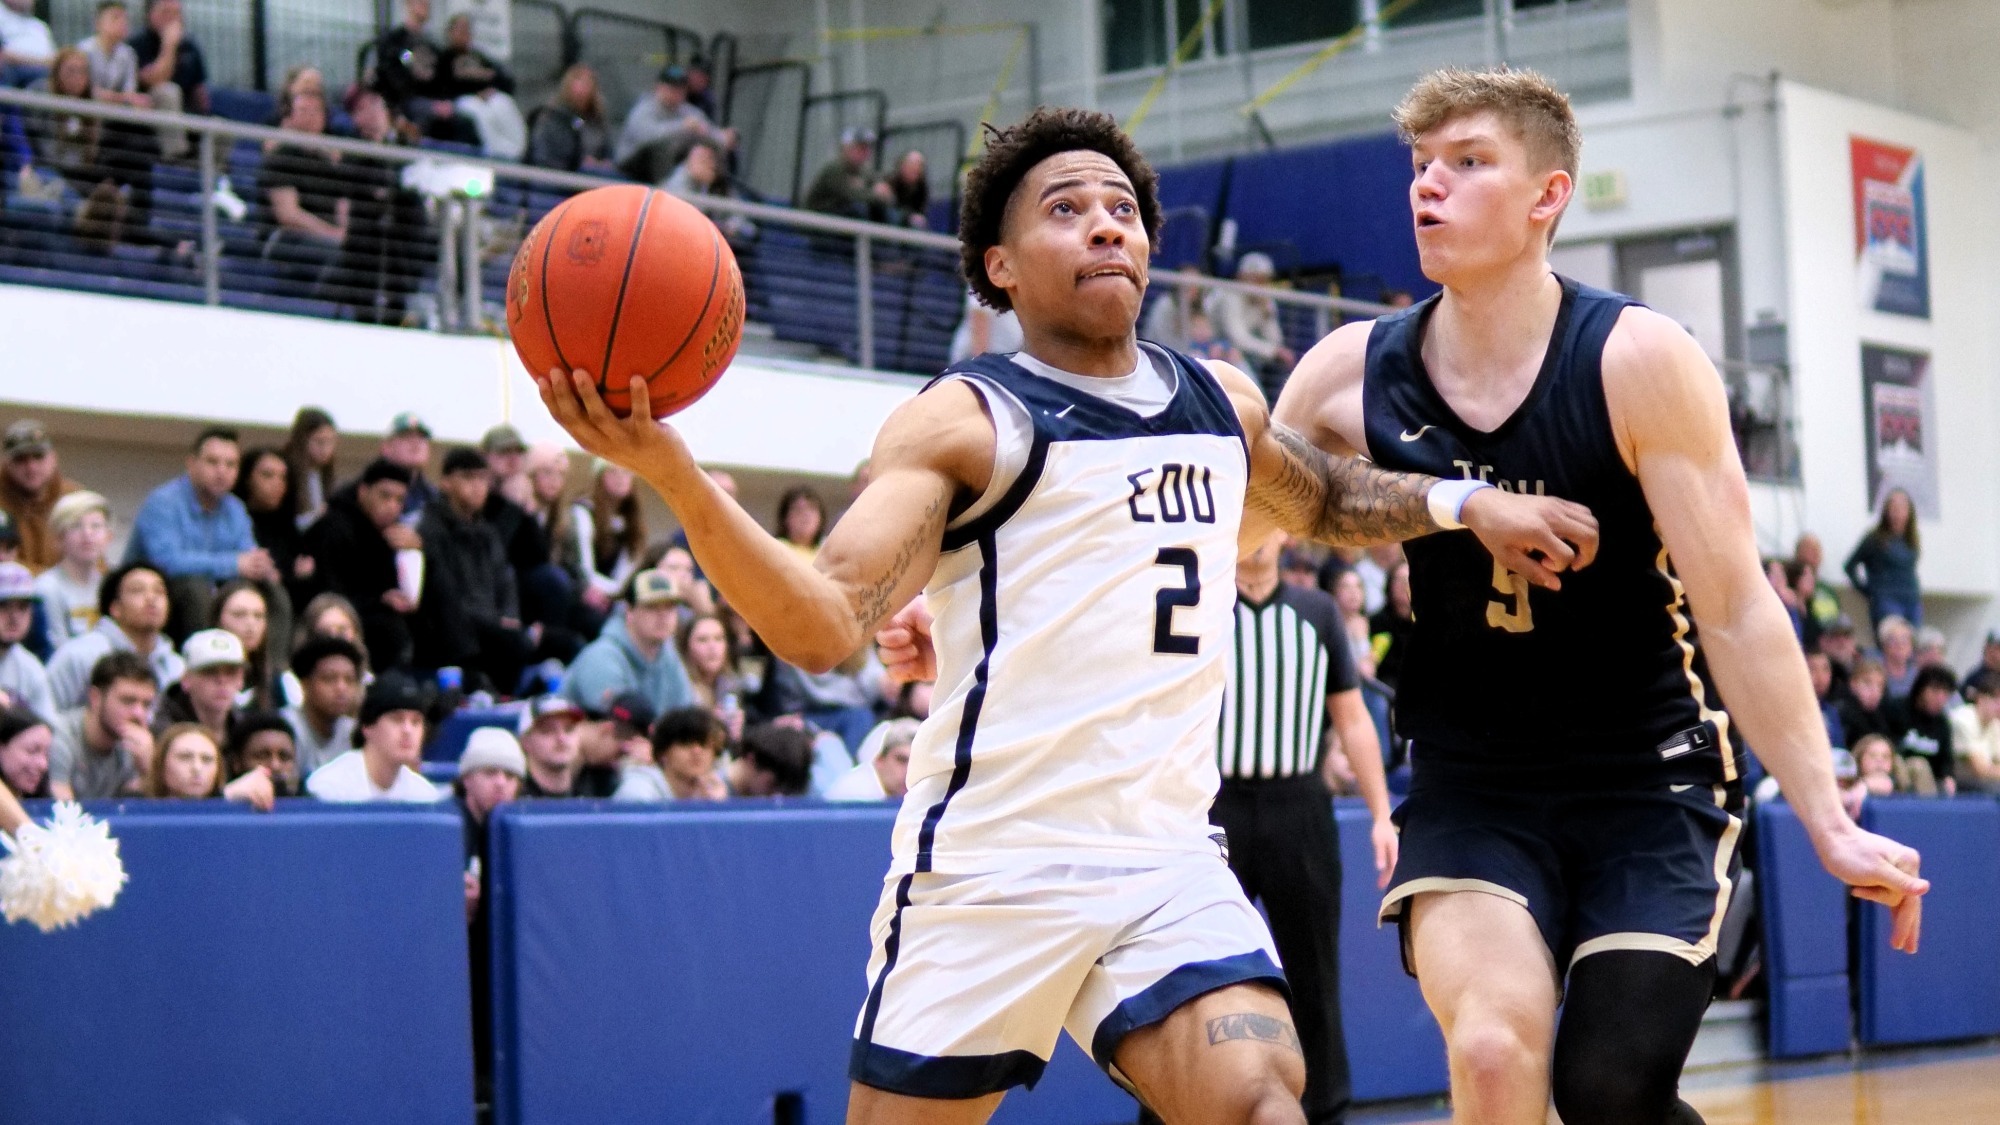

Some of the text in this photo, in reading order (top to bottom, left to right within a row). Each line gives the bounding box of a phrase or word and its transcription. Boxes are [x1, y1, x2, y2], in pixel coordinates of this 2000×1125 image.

[1127, 463, 1216, 524] EOU
[1152, 546, 1202, 656] 2
[1693, 733, 1704, 744] L
